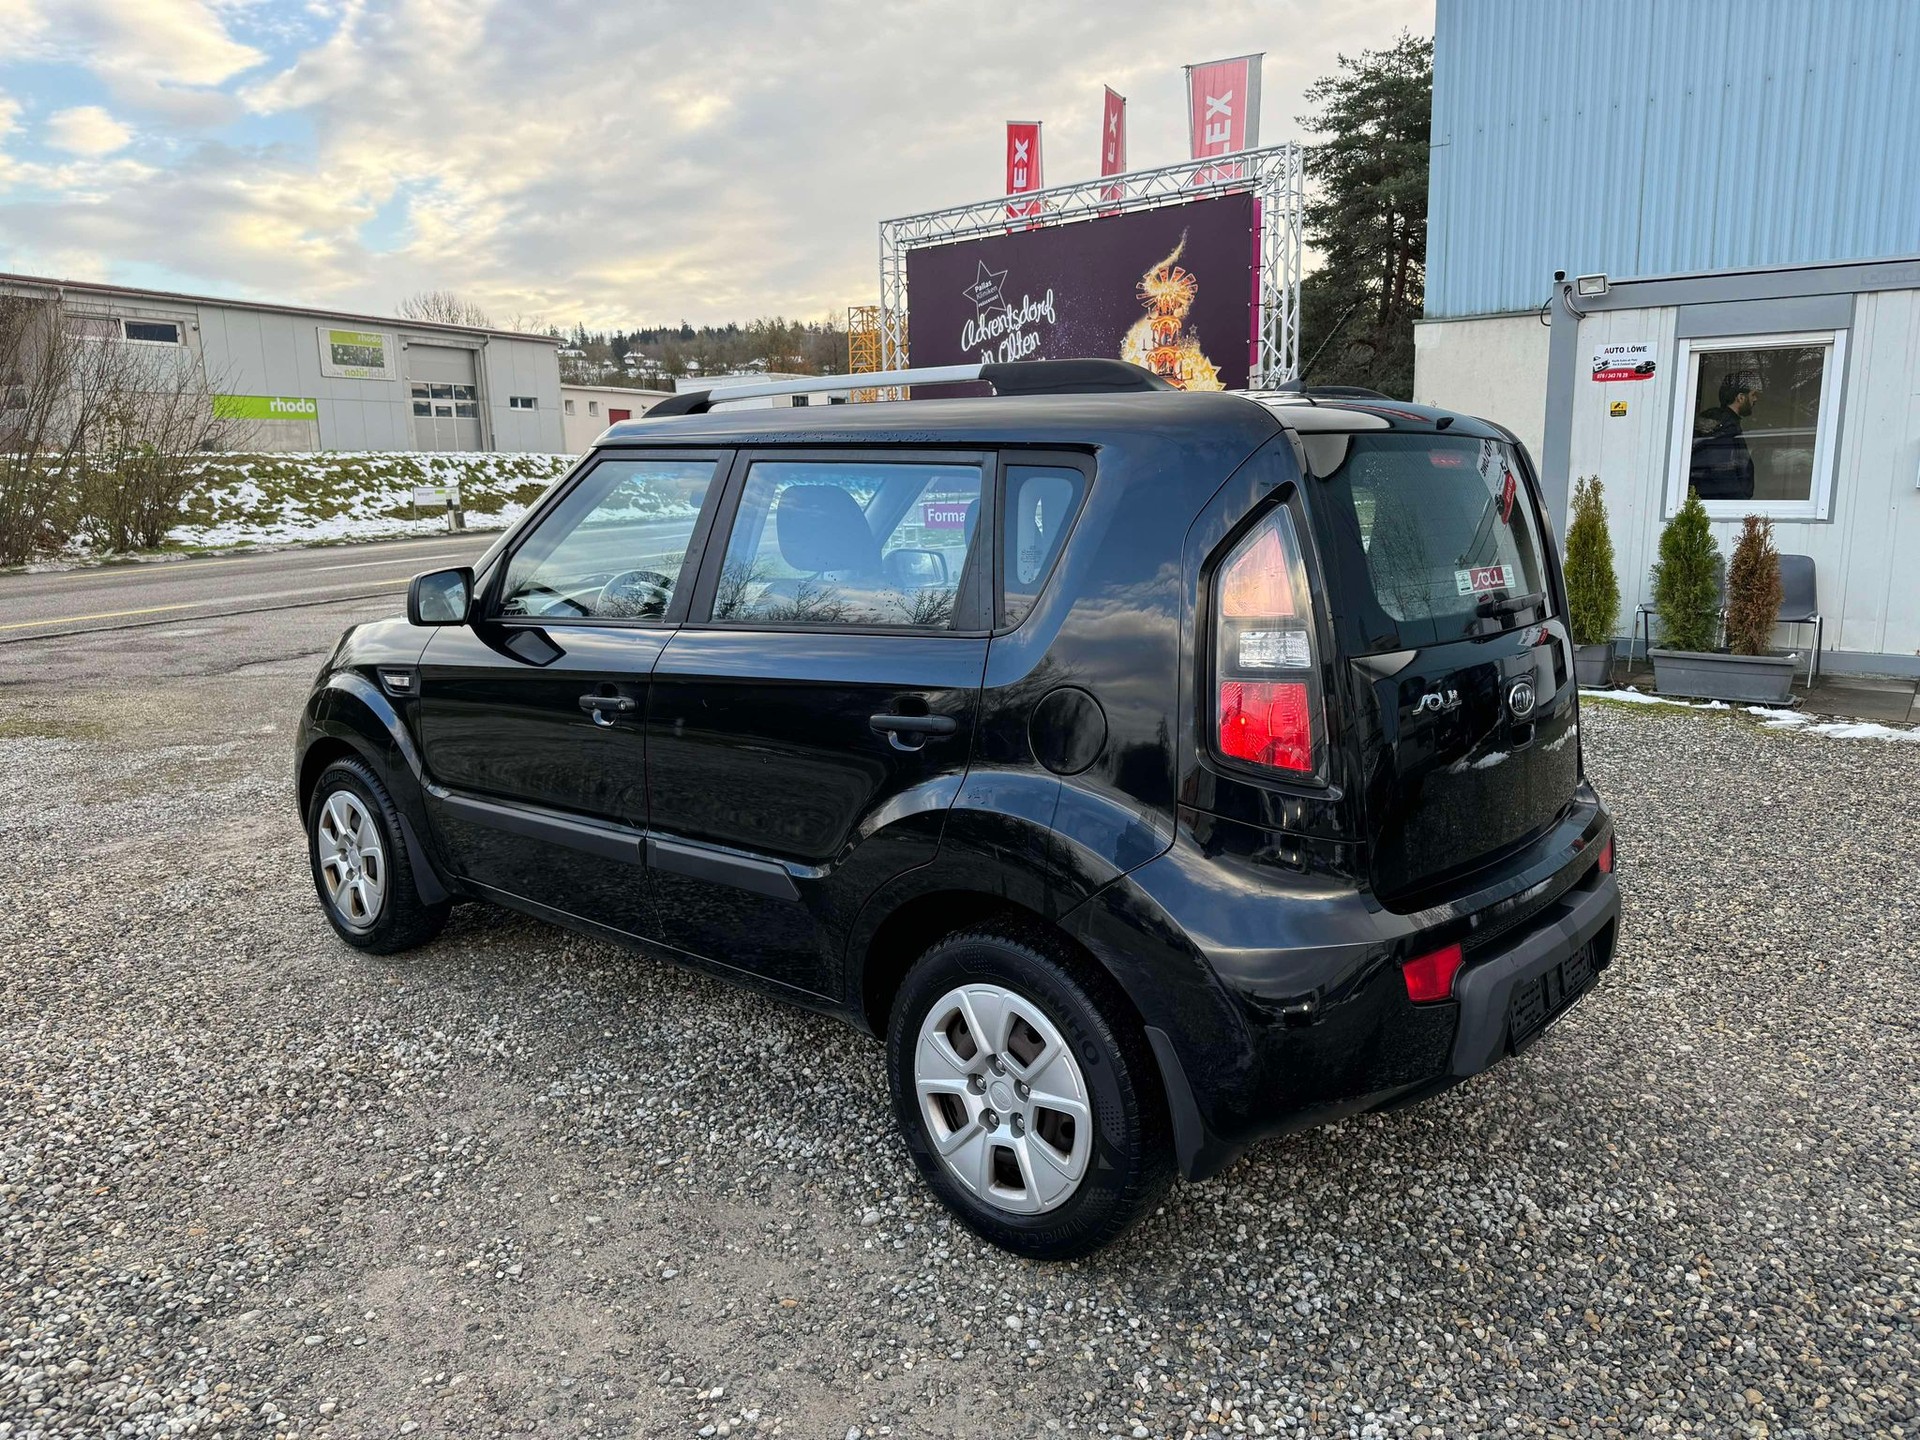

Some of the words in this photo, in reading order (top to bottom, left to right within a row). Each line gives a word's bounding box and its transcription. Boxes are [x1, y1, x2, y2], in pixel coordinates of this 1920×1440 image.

[961, 289, 1055, 352] Adventsdorf
[357, 333, 382, 344] rhodo
[1627, 345, 1648, 353] LÖWE
[270, 397, 316, 414] rhodo
[927, 508, 966, 522] Forma
[1473, 567, 1504, 588] SOUL
